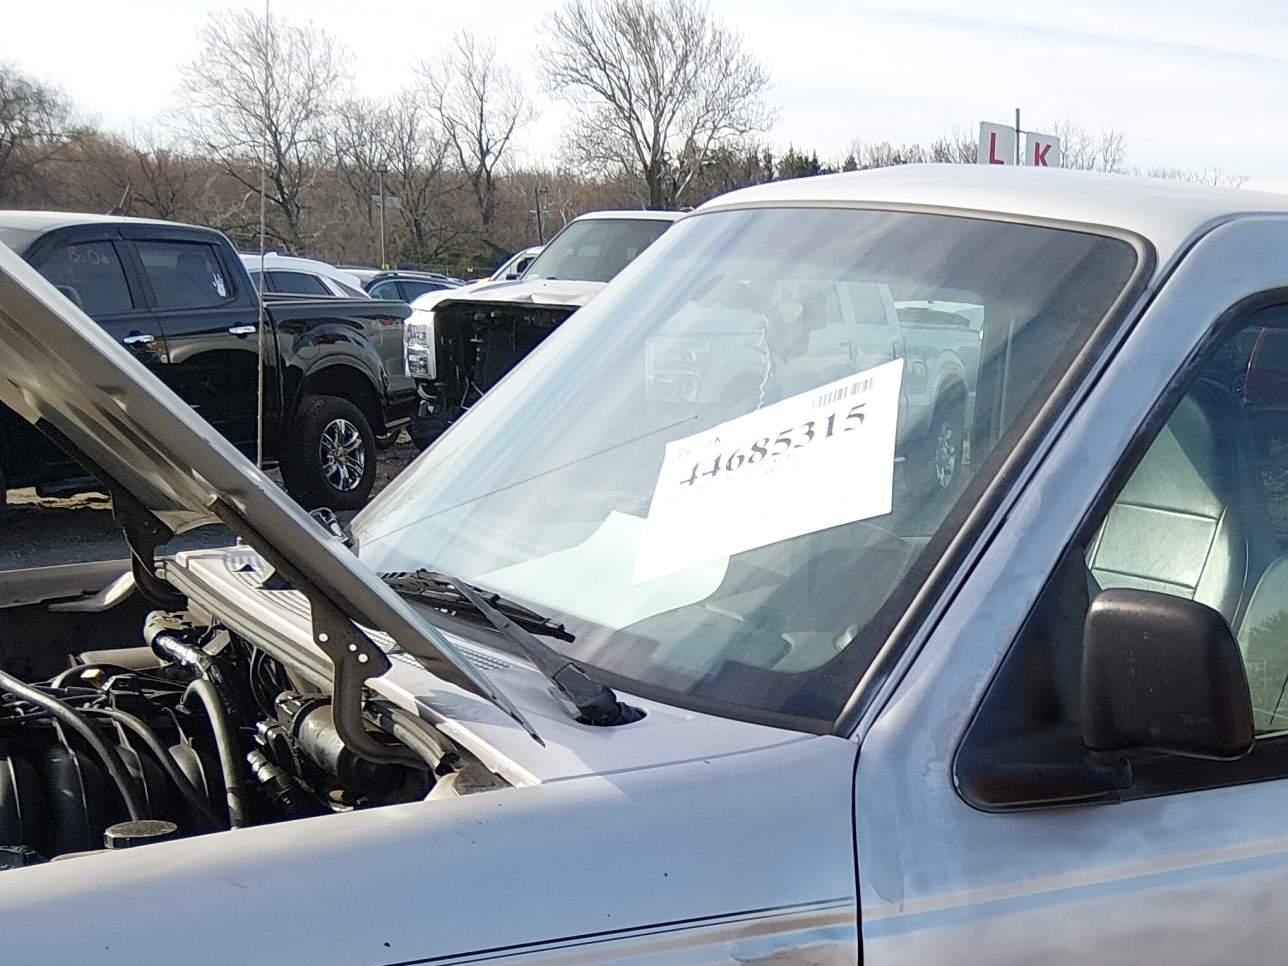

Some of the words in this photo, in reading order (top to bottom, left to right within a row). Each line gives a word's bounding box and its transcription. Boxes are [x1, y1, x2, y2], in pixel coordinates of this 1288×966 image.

[989, 131, 1005, 165] L
[1034, 142, 1052, 167] K
[679, 402, 868, 487] 44685315
